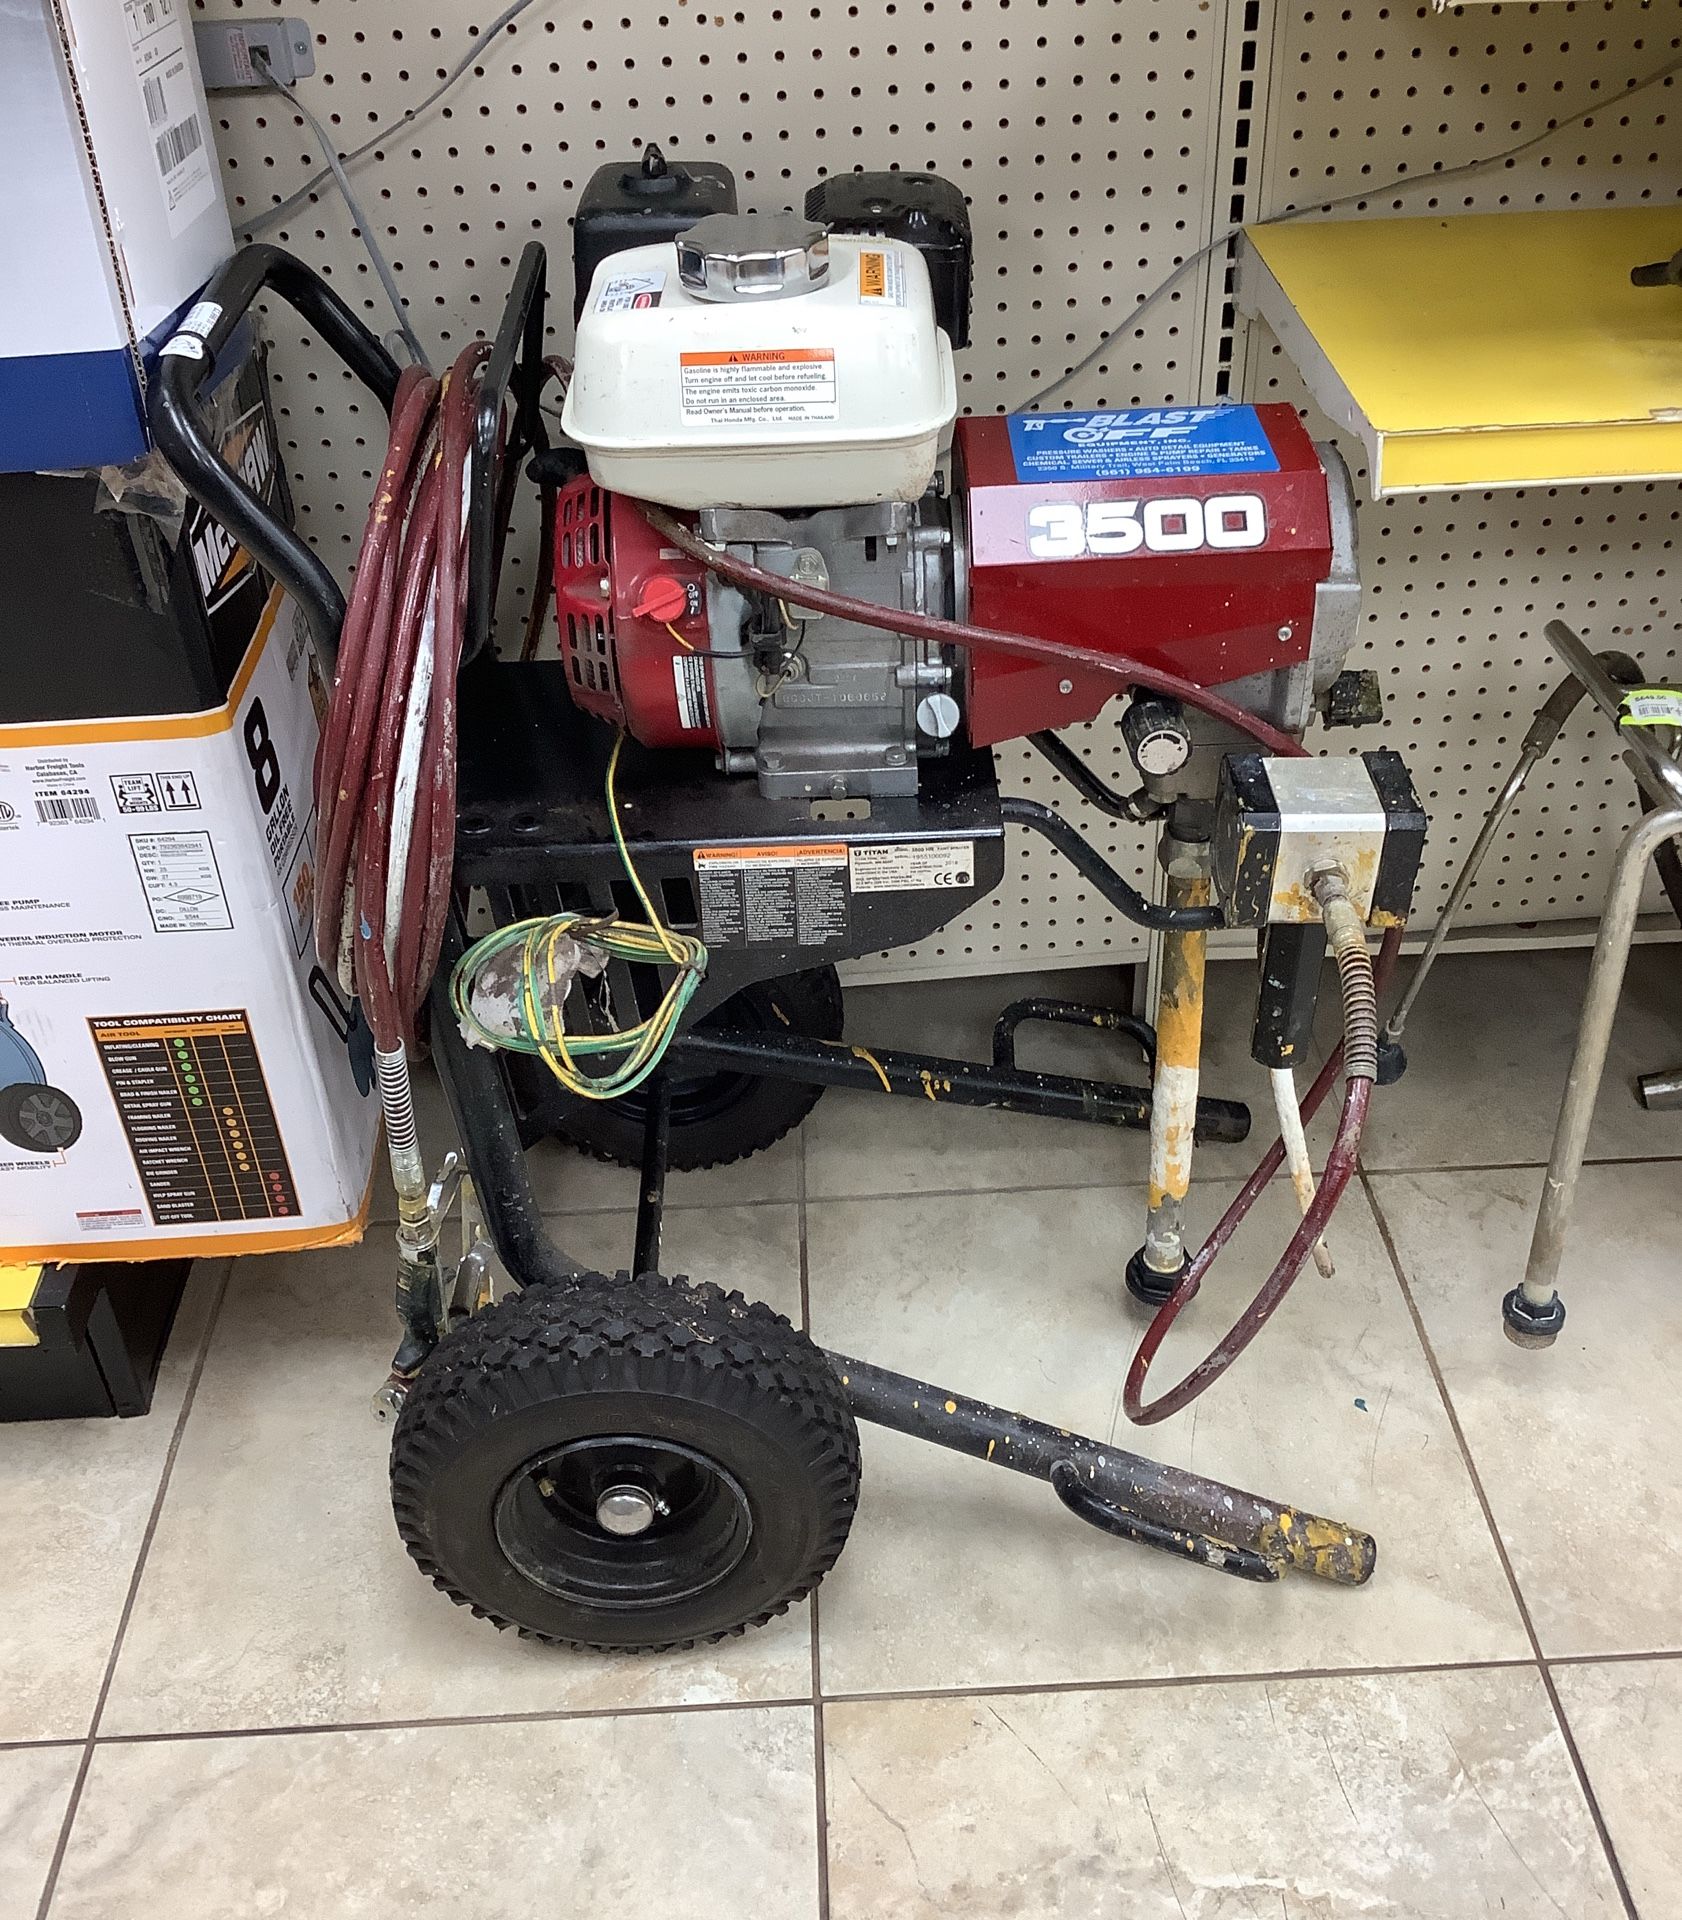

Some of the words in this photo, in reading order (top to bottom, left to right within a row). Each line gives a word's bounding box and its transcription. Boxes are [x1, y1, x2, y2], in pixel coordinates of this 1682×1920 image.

[742, 352, 785, 361] WARNING
[720, 366, 739, 375] highly
[741, 364, 776, 372] flammable
[792, 363, 822, 372] explosive
[701, 376, 721, 385] engine
[774, 373, 795, 381] before
[699, 388, 720, 396] engine
[730, 406, 751, 414] Manual
[1088, 410, 1220, 427] BLAST
[1063, 426, 1198, 443] OFF
[1078, 440, 1160, 448] EQUIPMENT,
[1193, 441, 1245, 449] EQUIPMENT
[1027, 493, 1267, 560] 3500
[244, 696, 280, 815] 8
[266, 784, 290, 843] GALLON
[279, 799, 293, 835] FREE
[11, 902, 70, 911] MAINTENANCE
[8, 940, 45, 948] THERMAL
[48, 937, 90, 945] OVERLOAD
[92, 934, 142, 943] PROTECTION
[35, 933, 86, 941] INDUCTION
[37, 978, 79, 986] BALANCED
[81, 976, 110, 984] LIFTING
[123, 1016, 204, 1027] COMPATIBILITY
[205, 1013, 242, 1022] CHART
